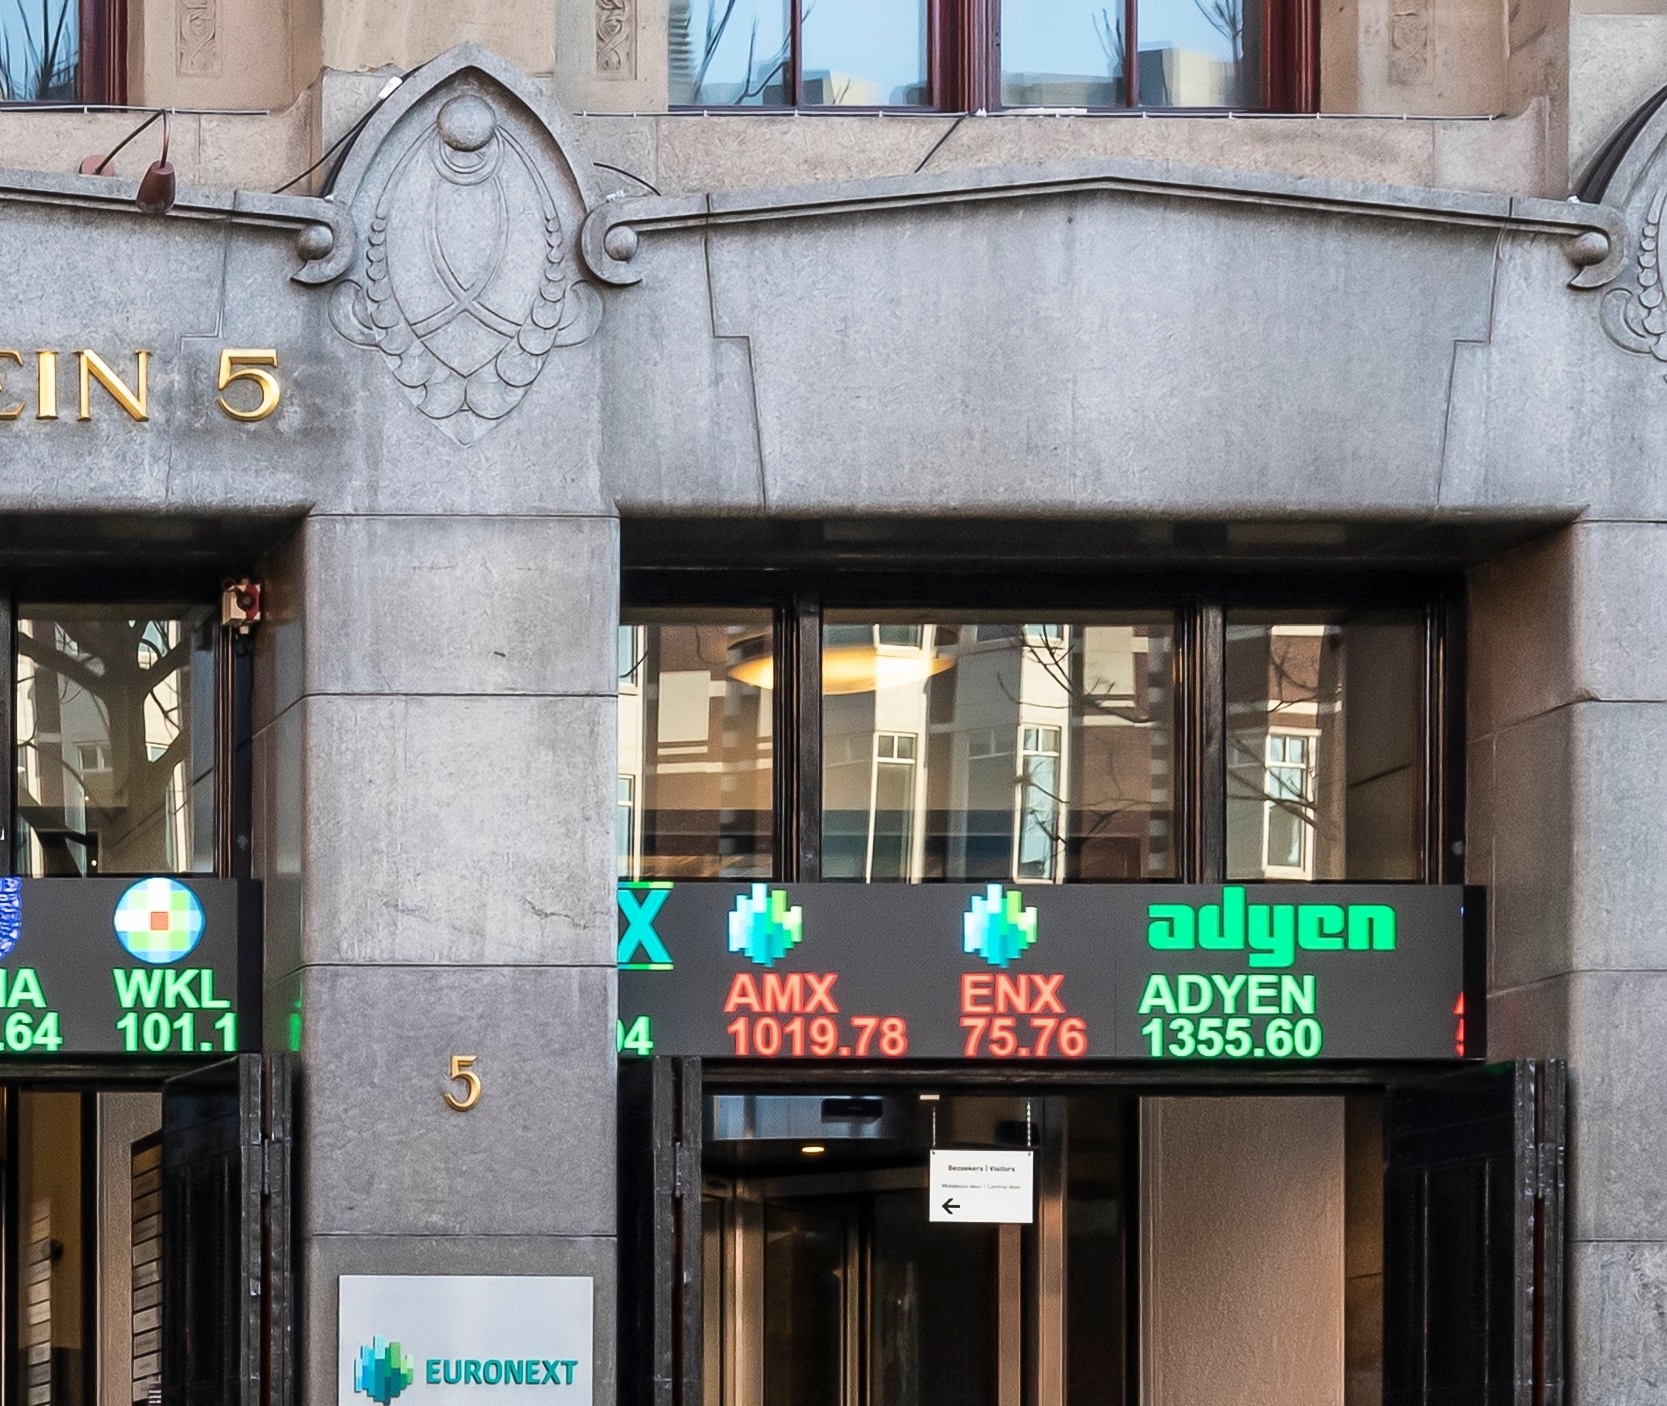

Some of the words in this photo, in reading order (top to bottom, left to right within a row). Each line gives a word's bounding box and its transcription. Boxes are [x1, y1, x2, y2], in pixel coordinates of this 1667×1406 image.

[216, 347, 280, 422] 5
[1147, 886, 1396, 968] adyen
[113, 968, 231, 1009] WKL
[724, 973, 839, 1014] AMX
[961, 974, 1066, 1014] ENX
[1138, 974, 1316, 1015] ADYEN
[617, 1016, 654, 1056] 4
[727, 1016, 909, 1057] 1019.78
[960, 1016, 1088, 1057] 75.76
[1141, 1018, 1322, 1057] 1355.60
[445, 1055, 482, 1111] 5
[426, 1359, 579, 1386] EURONEXT
